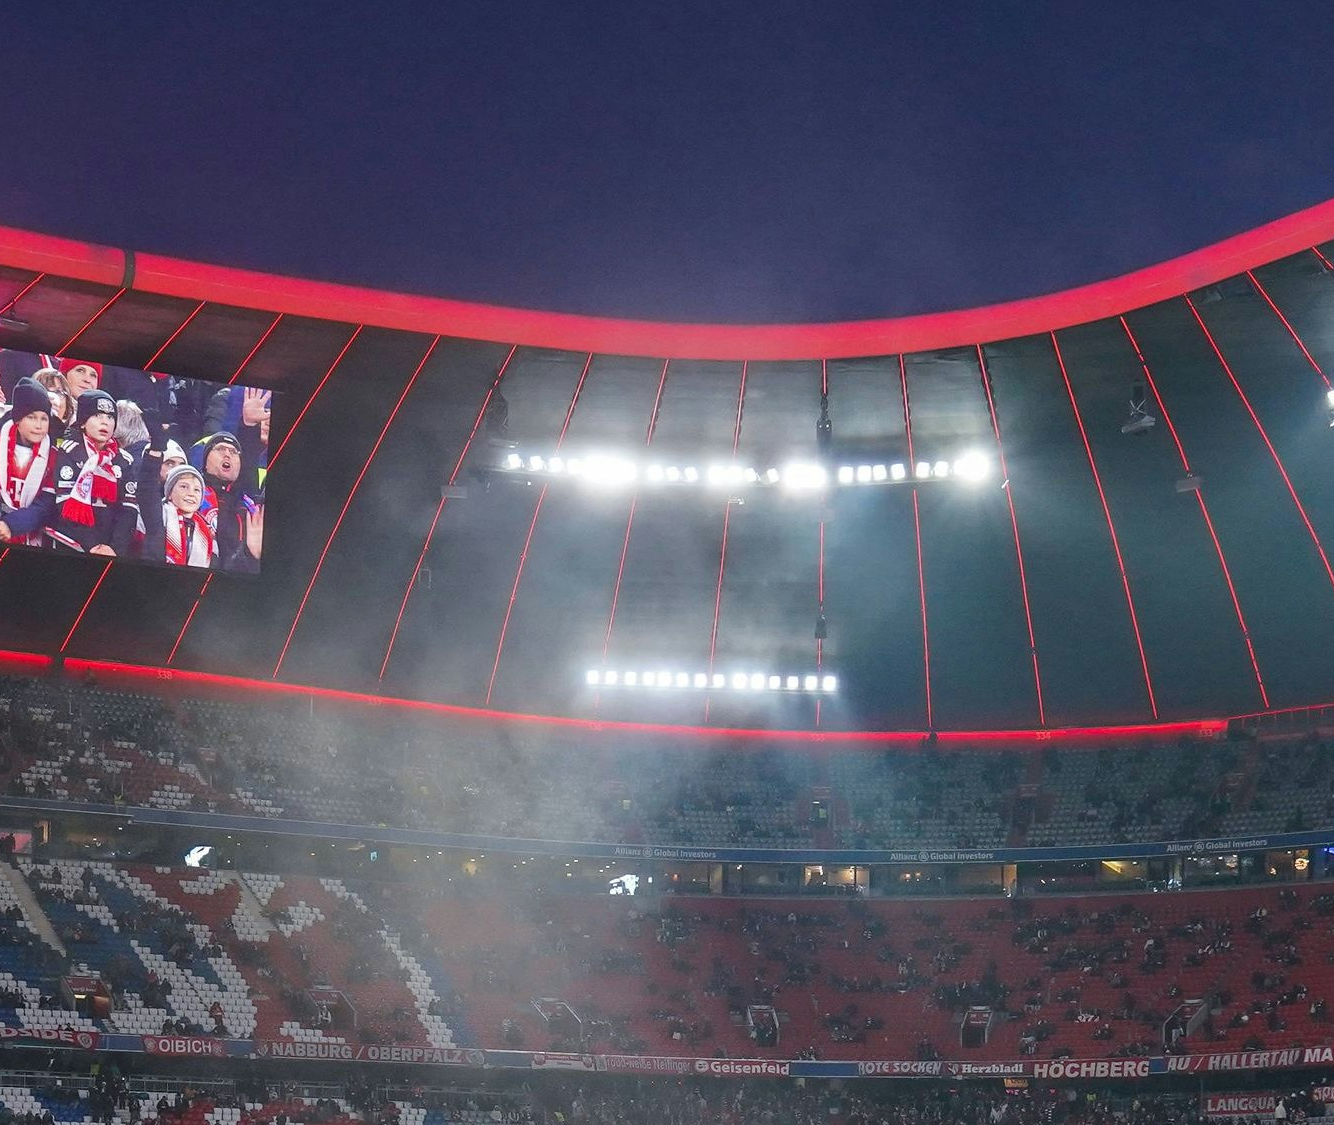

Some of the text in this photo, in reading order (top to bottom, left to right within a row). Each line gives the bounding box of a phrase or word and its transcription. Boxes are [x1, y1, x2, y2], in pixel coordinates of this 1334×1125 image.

[654, 847, 678, 858] Global
[679, 849, 717, 860] Investors
[890, 850, 994, 862] Allianz Global Investors
[158, 1039, 213, 1054] OIBICH
[272, 1041, 354, 1060] NABBURG
[367, 1046, 463, 1063] OBERPFALZ
[710, 1060, 790, 1076] Geisenfeld
[892, 1060, 943, 1074] SOCKEN
[961, 1062, 1024, 1074] Herzbladl
[1033, 1057, 1150, 1079] HÖCHBERG
[1167, 1057, 1192, 1073] AU
[1208, 1048, 1299, 1071] HALLERTAU
[1207, 1096, 1277, 1112] LANGQUA
